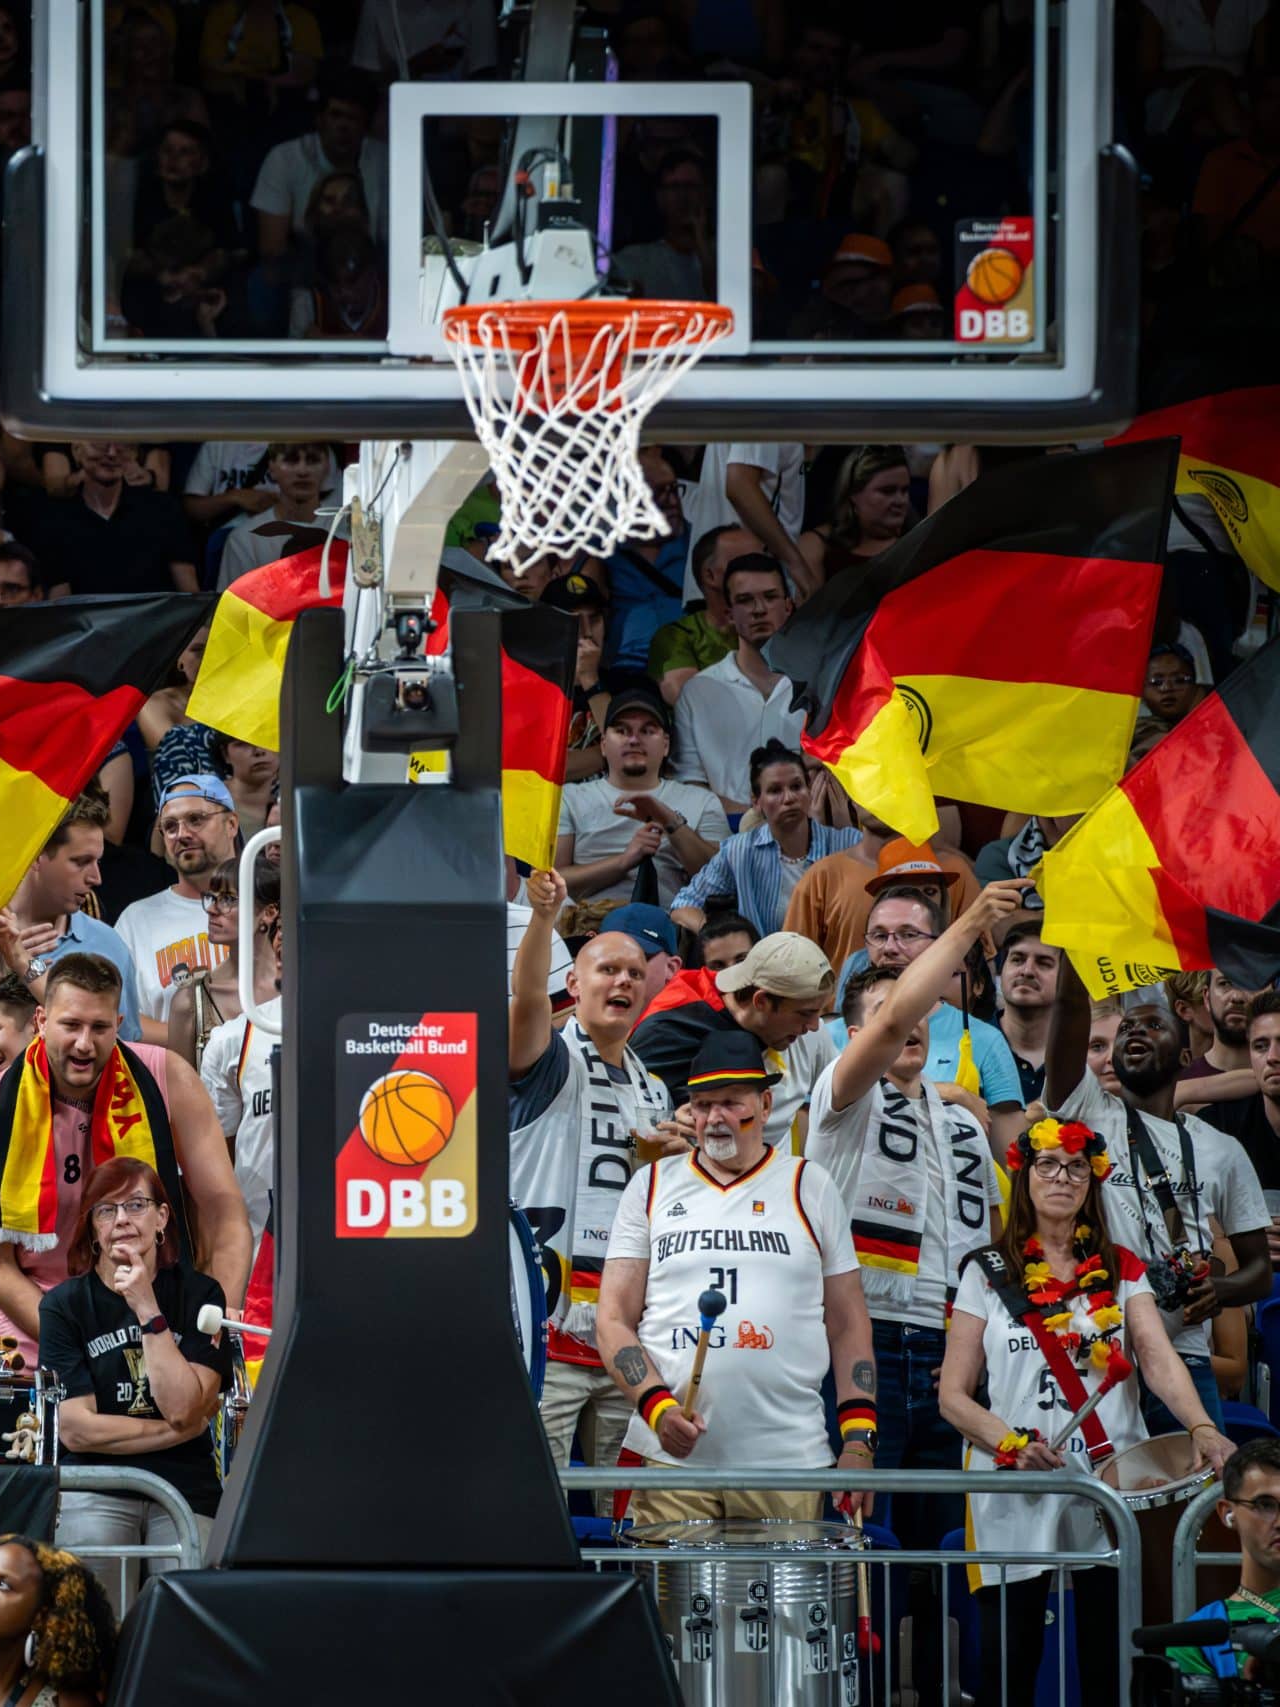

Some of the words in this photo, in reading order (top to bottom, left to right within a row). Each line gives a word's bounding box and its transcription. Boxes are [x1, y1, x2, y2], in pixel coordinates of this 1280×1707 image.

[960, 309, 1030, 339] DBB
[369, 1023, 445, 1037] Deutscher
[346, 1040, 424, 1054] Basketball
[428, 1040, 468, 1054] Bund
[253, 1089, 273, 1118] DE
[64, 1154, 81, 1184] 8
[346, 1179, 468, 1228] DBB
[868, 1196, 893, 1210] ING
[583, 1229, 610, 1241] ING
[658, 1230, 791, 1263] DEUTSCHLAND
[709, 1268, 738, 1304] 21
[87, 1328, 128, 1358] WORLD
[672, 1325, 727, 1350] ING
